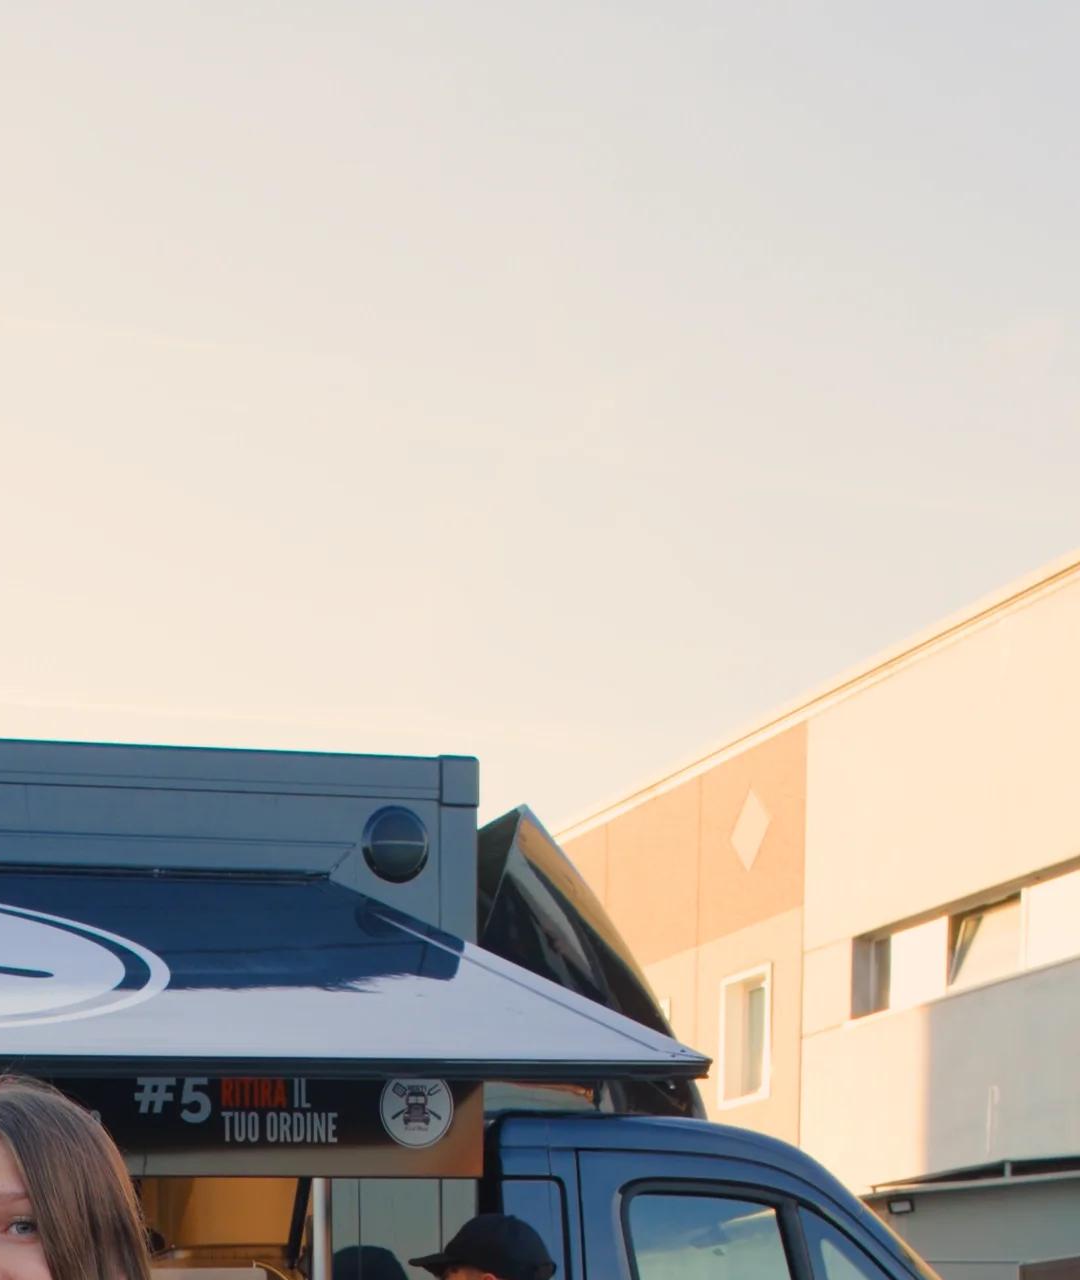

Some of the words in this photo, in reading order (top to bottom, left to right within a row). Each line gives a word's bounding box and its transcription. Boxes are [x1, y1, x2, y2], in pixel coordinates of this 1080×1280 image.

[134, 1077, 212, 1124] #5
[221, 1078, 287, 1108] RITIRA
[293, 1078, 311, 1108] IL
[222, 1112, 260, 1143] TUO
[266, 1112, 338, 1143] ORDINE
